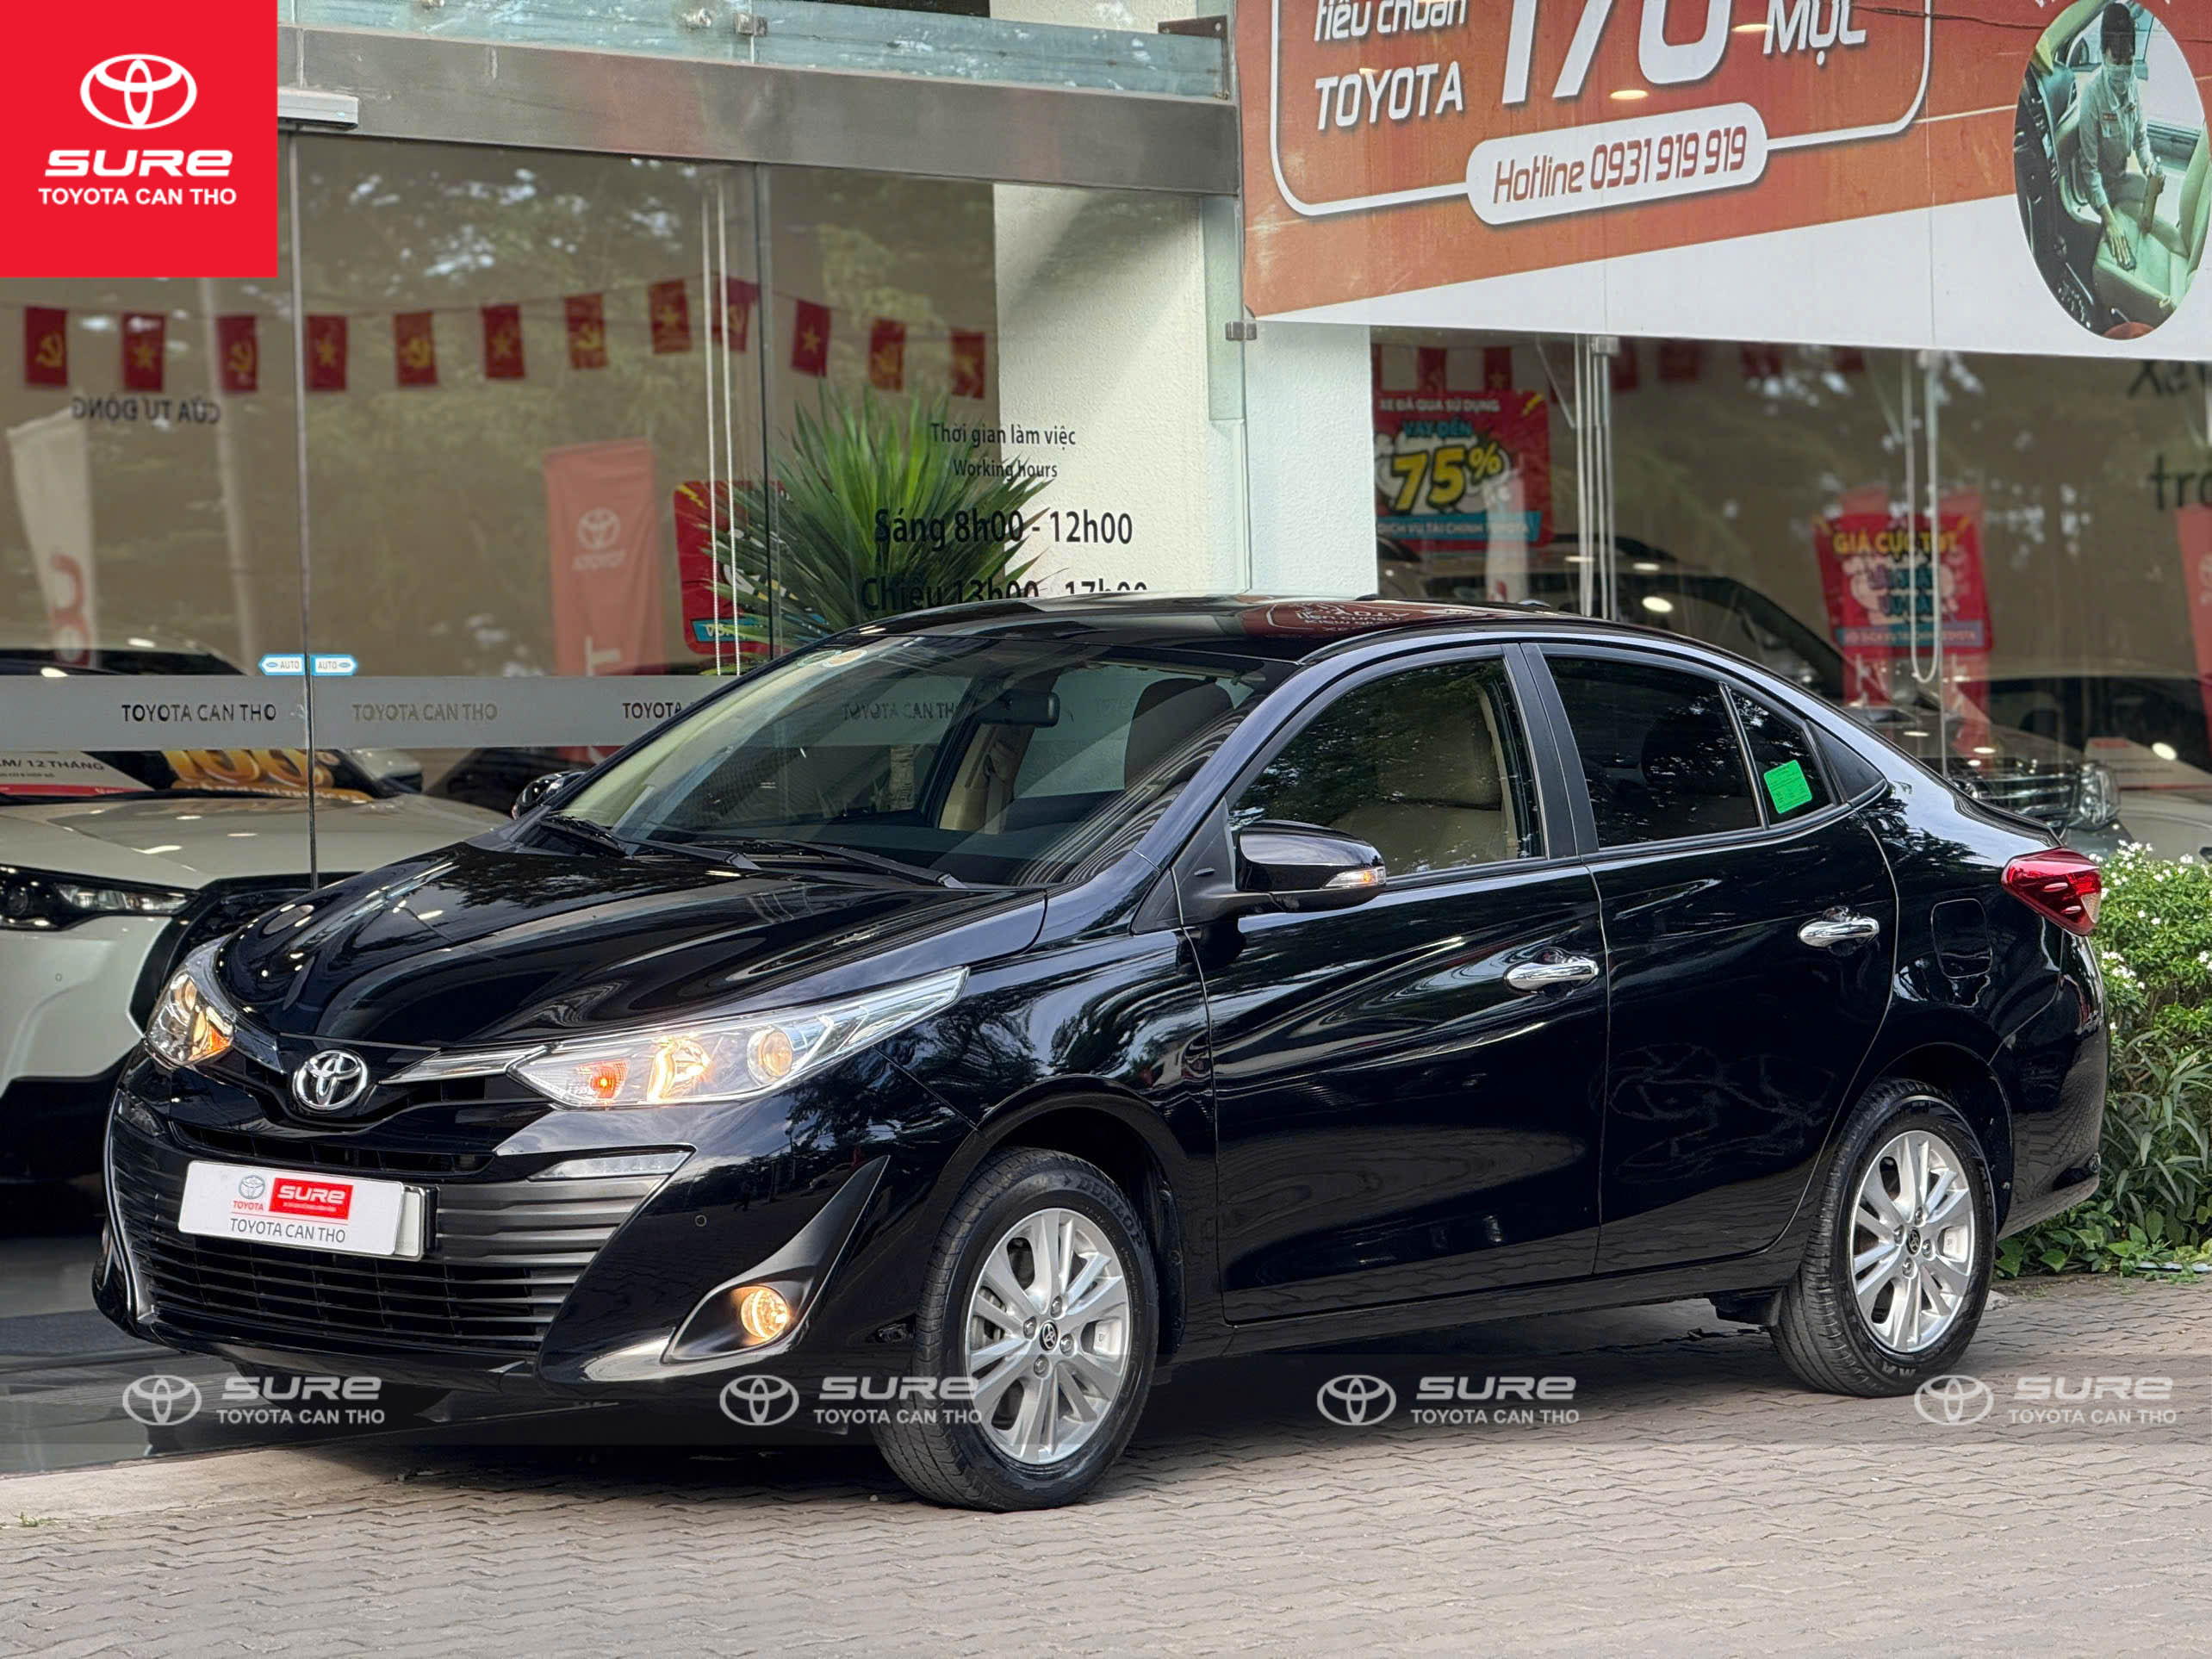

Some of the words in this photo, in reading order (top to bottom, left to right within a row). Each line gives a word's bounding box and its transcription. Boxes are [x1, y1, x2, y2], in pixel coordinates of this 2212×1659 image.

[1763, 0, 1867, 66] MỤC
[1315, 60, 1463, 130] TOYOTA
[1493, 155, 1585, 204] Hotline
[1590, 138, 1651, 190] 0931
[1656, 132, 1700, 182] 919
[1705, 125, 1748, 174] 919
[931, 422, 967, 443] Thời
[972, 423, 1007, 449] gian
[1011, 424, 1041, 444] làm
[1045, 426, 1077, 450] việc
[954, 459, 1014, 482] Working
[1017, 459, 1059, 478] hours
[1392, 441, 1504, 513] 75%
[874, 507, 946, 552] Sáng
[954, 506, 1025, 544] 8h00
[1049, 509, 1134, 544] 12h00
[280, 661, 300, 669] AUTO
[318, 661, 338, 669] AUTO
[121, 704, 192, 722] TOYOTA
[197, 704, 234, 722] CAN
[239, 704, 276, 722] THO
[352, 704, 419, 722] TOYOTA
[423, 704, 459, 721] CAN
[462, 703, 498, 721] THO
[622, 702, 681, 718] TOYOTA
[233, 1200, 264, 1211] TOYOTA
[277, 1184, 345, 1205] SURE
[230, 1218, 282, 1237] TOYOTA
[285, 1223, 314, 1240] CAN
[318, 1227, 345, 1243] THO
